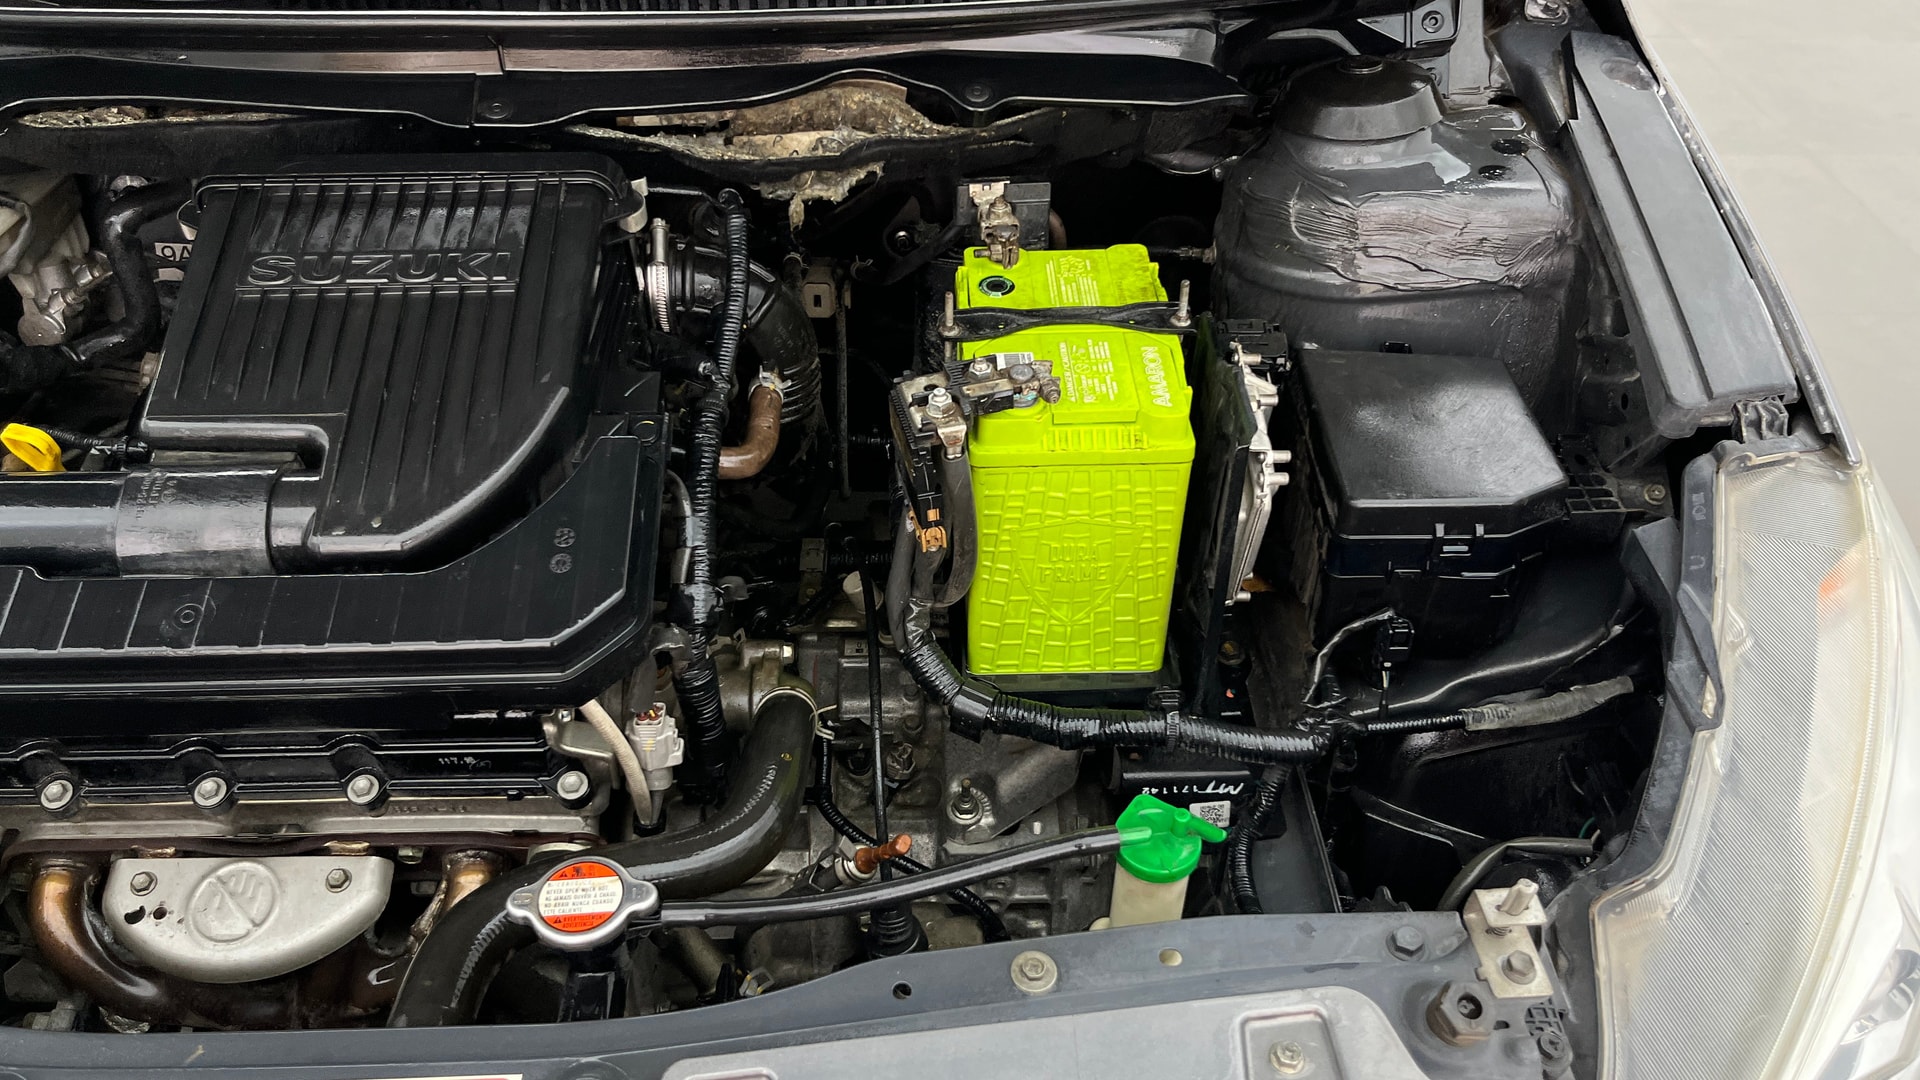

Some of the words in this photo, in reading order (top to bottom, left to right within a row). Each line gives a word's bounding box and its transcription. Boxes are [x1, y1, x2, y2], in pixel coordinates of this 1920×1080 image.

[247, 252, 511, 285] SUZUKI
[1140, 345, 1173, 407] AMARON
[1049, 543, 1098, 562] DURA
[1038, 563, 1107, 583] FRAME
